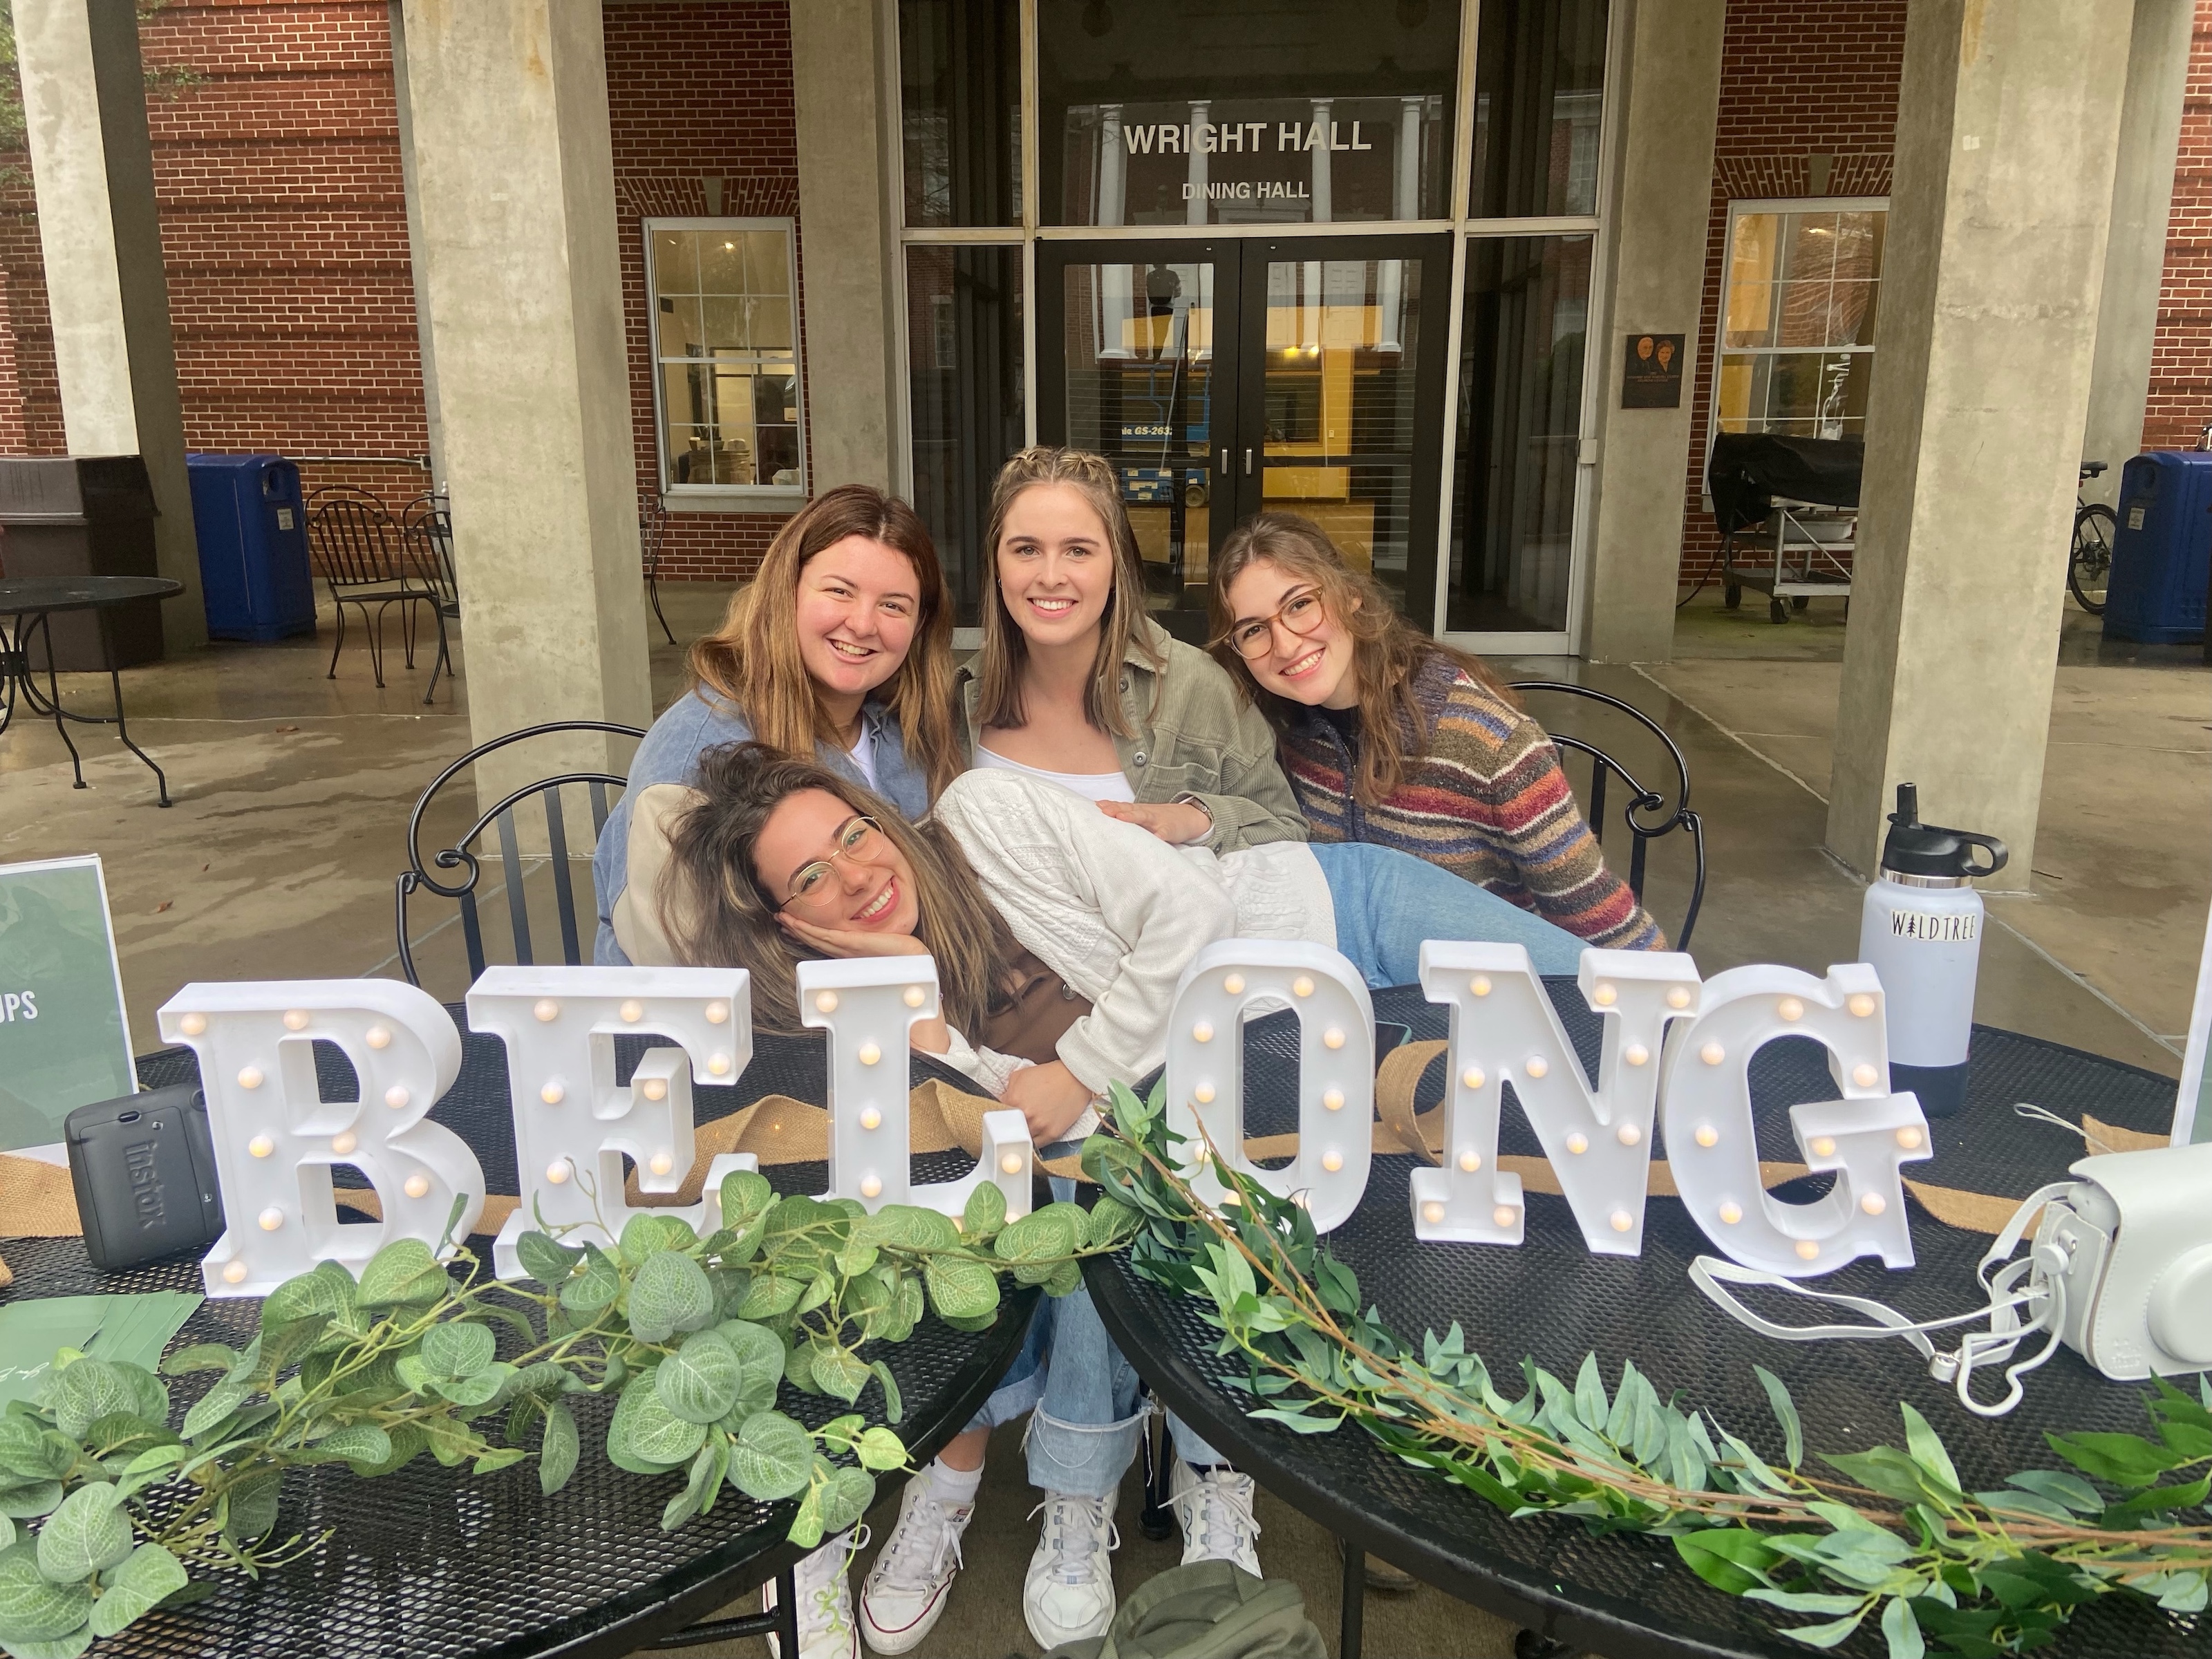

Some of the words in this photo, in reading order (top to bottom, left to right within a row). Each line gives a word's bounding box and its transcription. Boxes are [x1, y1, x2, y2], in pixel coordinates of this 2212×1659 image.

[1123, 122, 1267, 154] WRIGHT
[1278, 120, 1372, 151] HALL
[1181, 181, 1250, 200] DINING
[1257, 180, 1310, 198] HALL
[156, 938, 1933, 1300] BELONG
